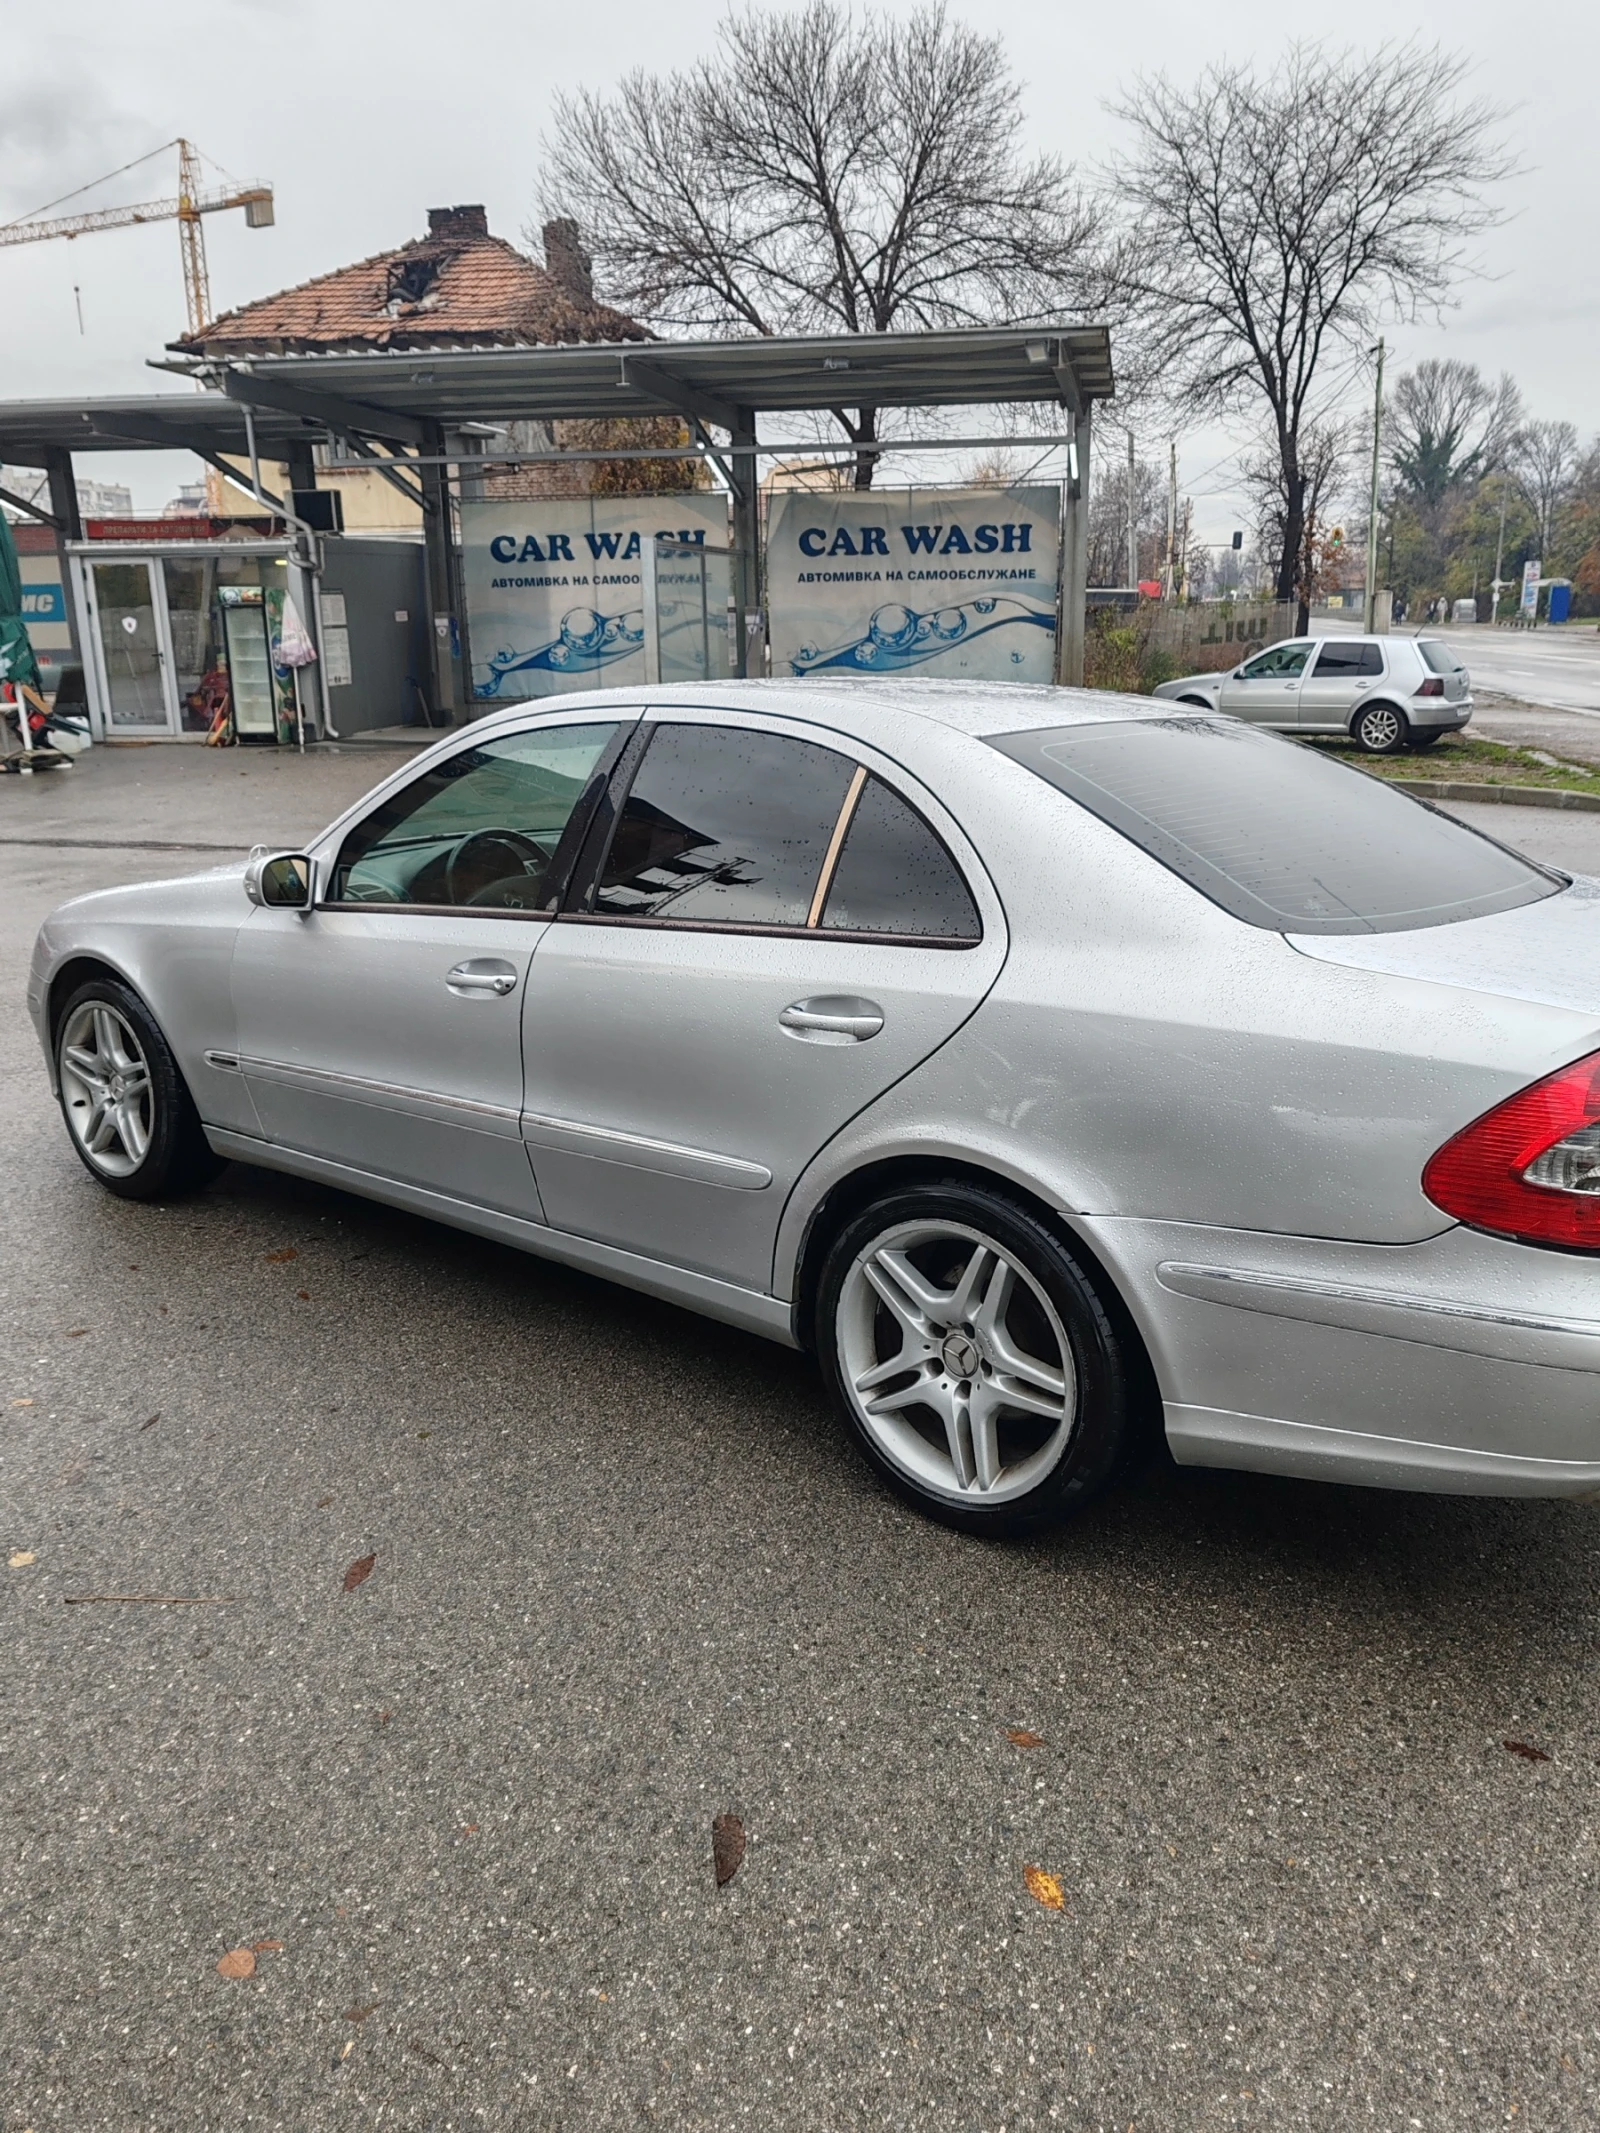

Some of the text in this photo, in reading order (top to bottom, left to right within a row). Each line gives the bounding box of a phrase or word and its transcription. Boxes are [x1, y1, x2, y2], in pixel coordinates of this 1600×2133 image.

[490, 530, 706, 563] CAR WASH
[798, 524, 1033, 557] CAR WASH
[491, 575, 569, 588] АВТОМИВКА
[573, 575, 589, 585] НА
[798, 568, 1037, 583] АВТОМИВКА НА САМООБСЛУЖАНЕ
